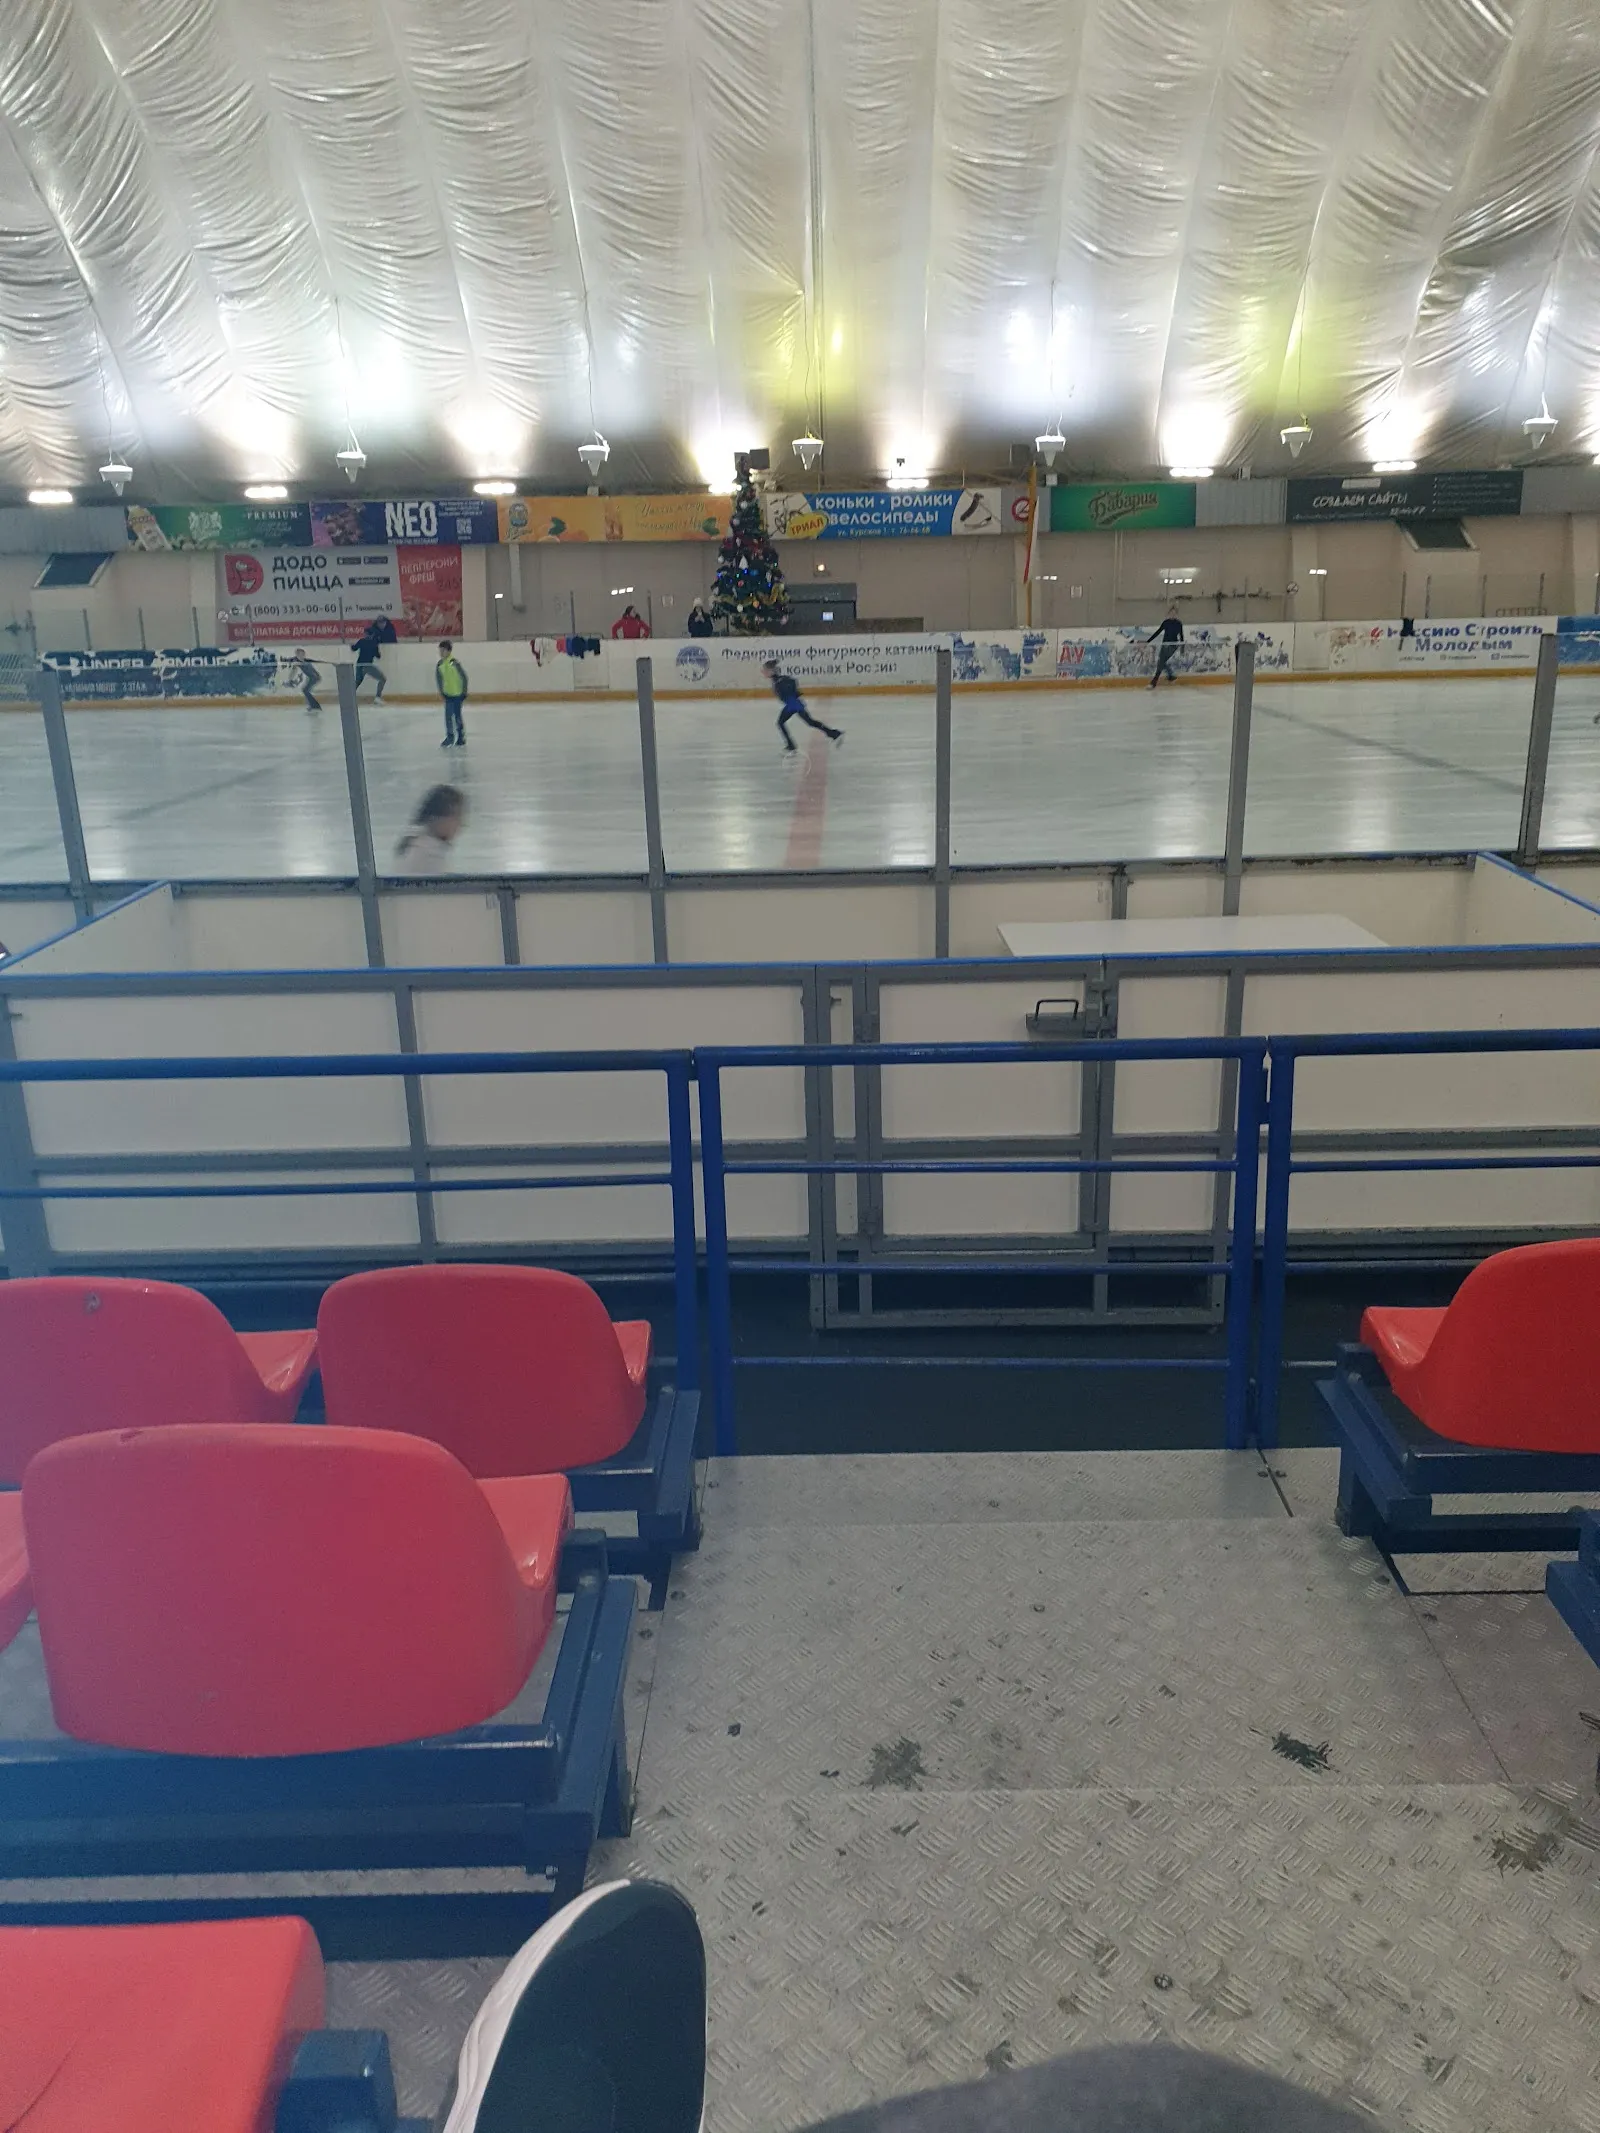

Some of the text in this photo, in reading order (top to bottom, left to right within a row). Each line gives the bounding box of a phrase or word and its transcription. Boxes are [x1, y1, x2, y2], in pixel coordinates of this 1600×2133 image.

[247, 510, 298, 521] PREMIUM
[385, 501, 438, 537] NEO
[791, 517, 824, 535] ТРИАЛ
[272, 555, 327, 572] ДОДО
[401, 557, 458, 574] ПЕППЕРОНИ
[273, 575, 343, 592] ПИЦЦА
[409, 572, 435, 584] ФРЕШ
[234, 624, 339, 637] БЕСЛАТНАЯ ДОСТАВКА
[805, 645, 881, 660] фигурного
[885, 643, 941, 656] катания
[82, 659, 144, 669] UNDER
[846, 662, 897, 674] Росии
